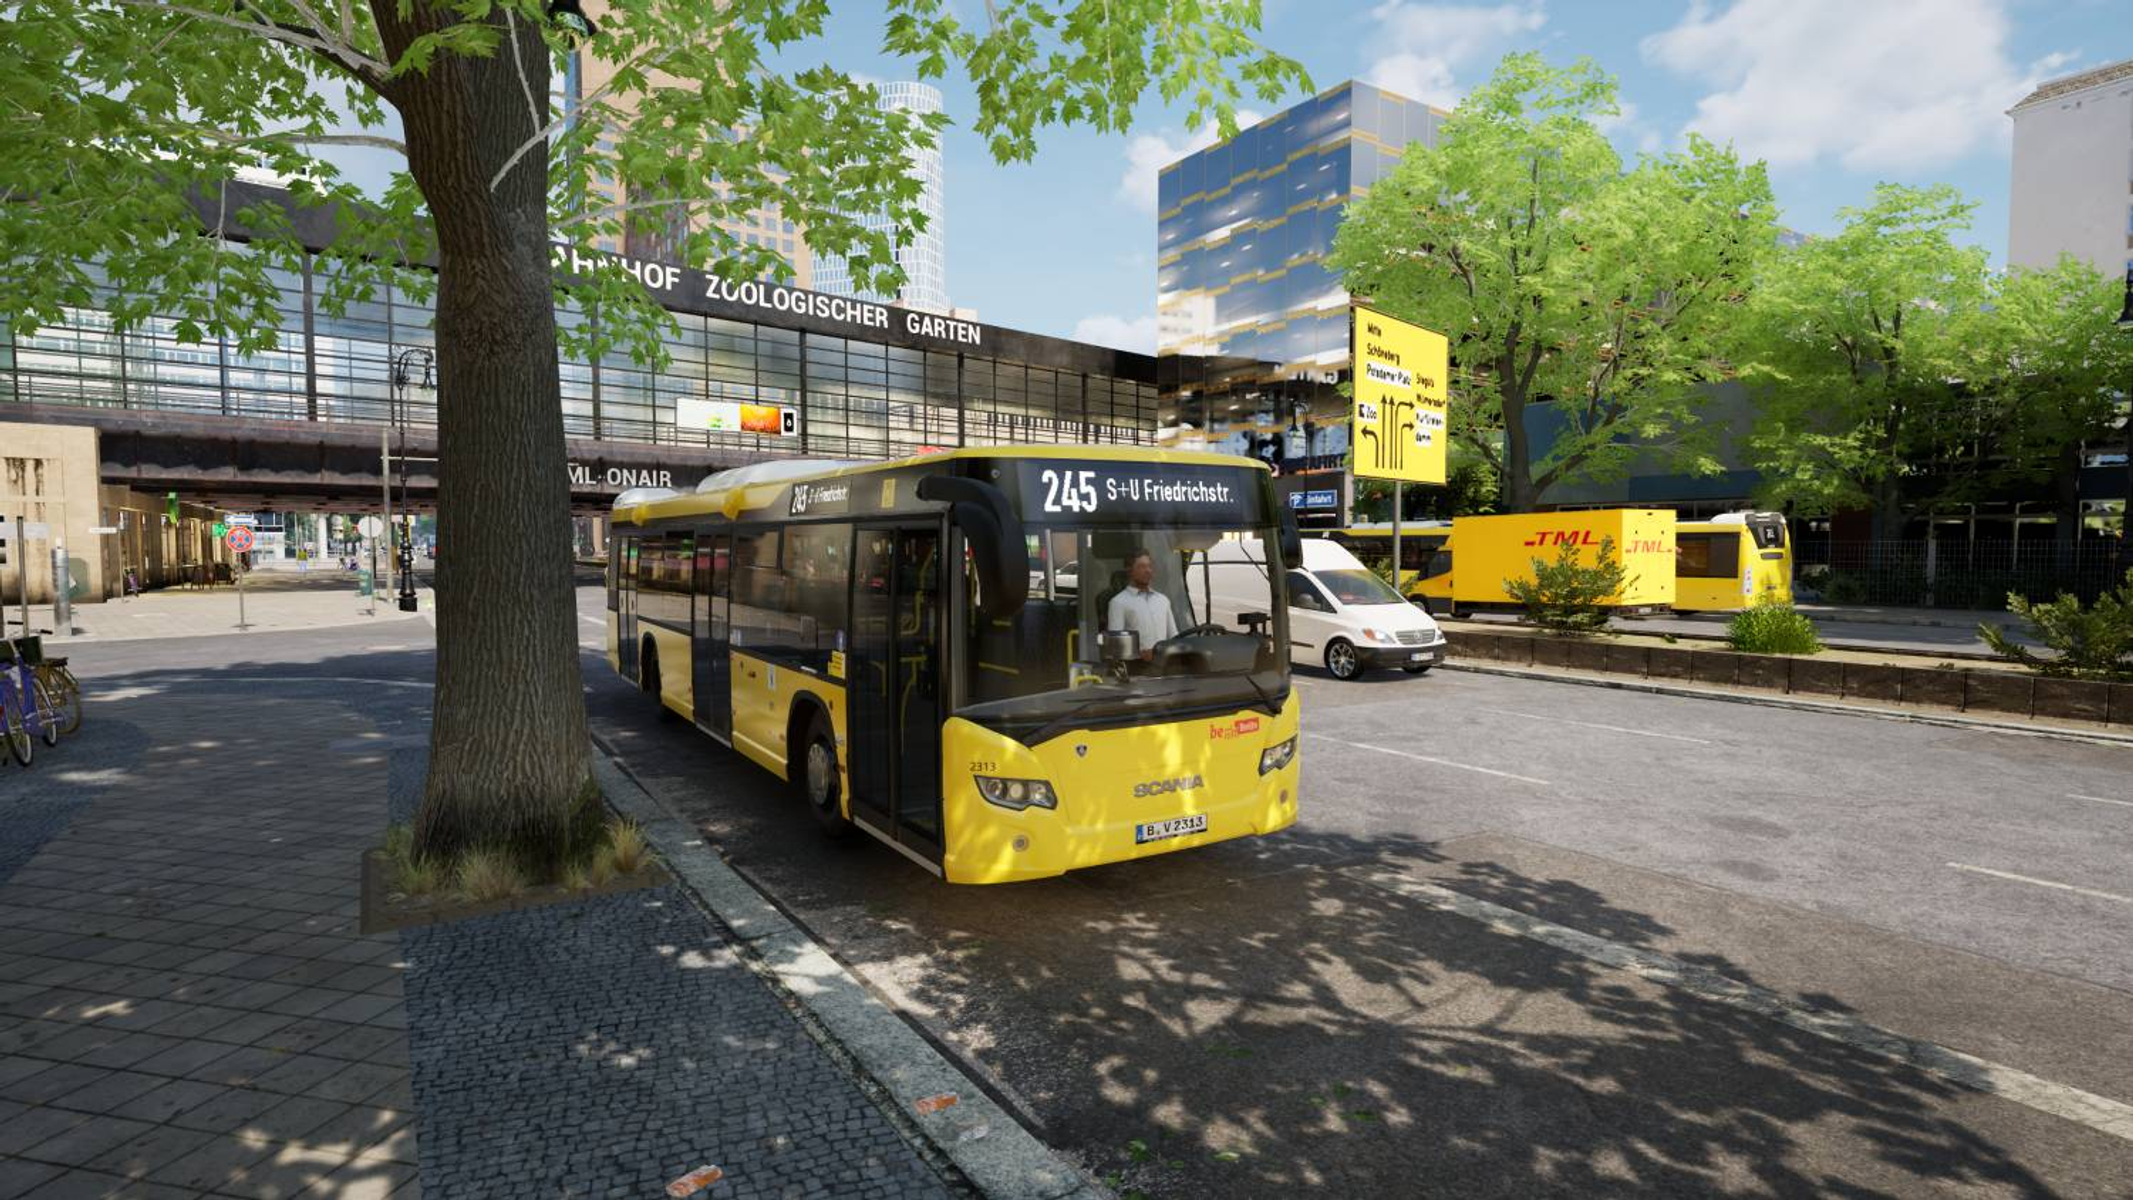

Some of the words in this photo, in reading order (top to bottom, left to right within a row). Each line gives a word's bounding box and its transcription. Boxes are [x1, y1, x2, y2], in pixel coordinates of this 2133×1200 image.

[705, 274, 889, 328] ZOOLOGISCHER
[906, 313, 982, 345] GARTEN
[1366, 342, 1400, 366] Schöneberg
[607, 467, 673, 488] ONAIR
[1041, 469, 1098, 512] 245
[1106, 478, 1140, 501] S+U
[1144, 479, 1235, 503] Friedrichstr.
[1534, 530, 1600, 546] TML
[1630, 540, 1668, 553] TML
[969, 761, 996, 772] 2313
[1133, 774, 1204, 797] SCANIA
[1174, 815, 1203, 831] 2313
